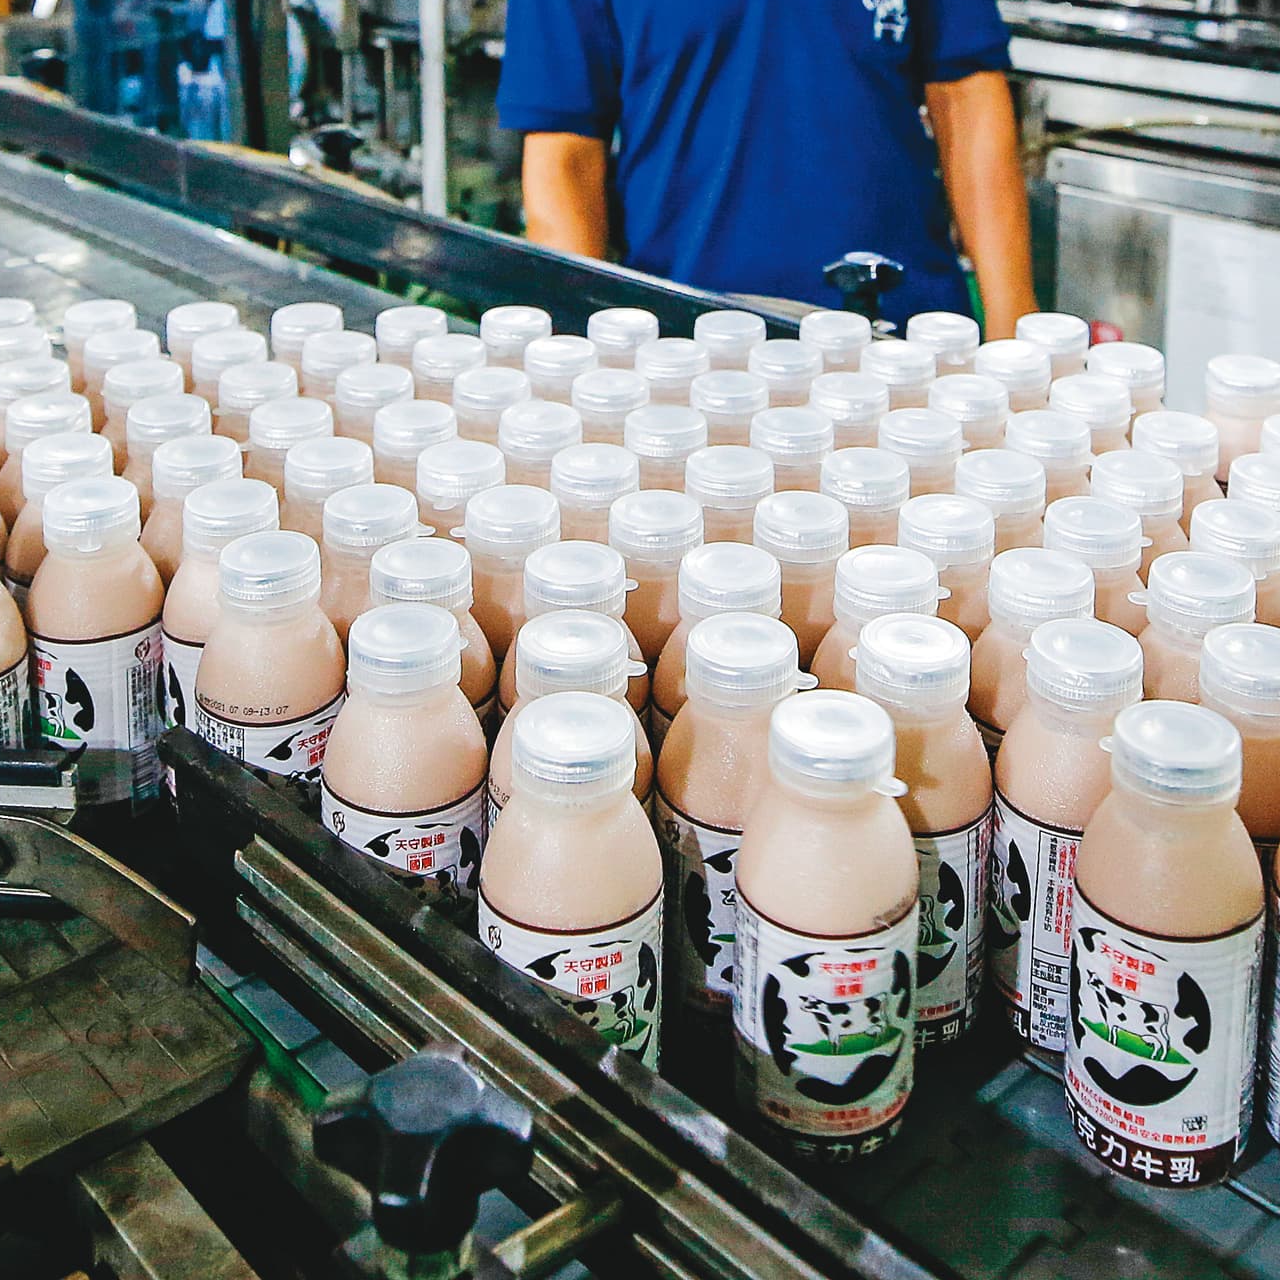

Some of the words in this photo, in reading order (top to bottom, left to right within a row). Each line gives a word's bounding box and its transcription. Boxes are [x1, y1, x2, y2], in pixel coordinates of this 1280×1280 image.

[395, 832, 446, 851] 天守製造
[563, 951, 622, 973] 天守製造
